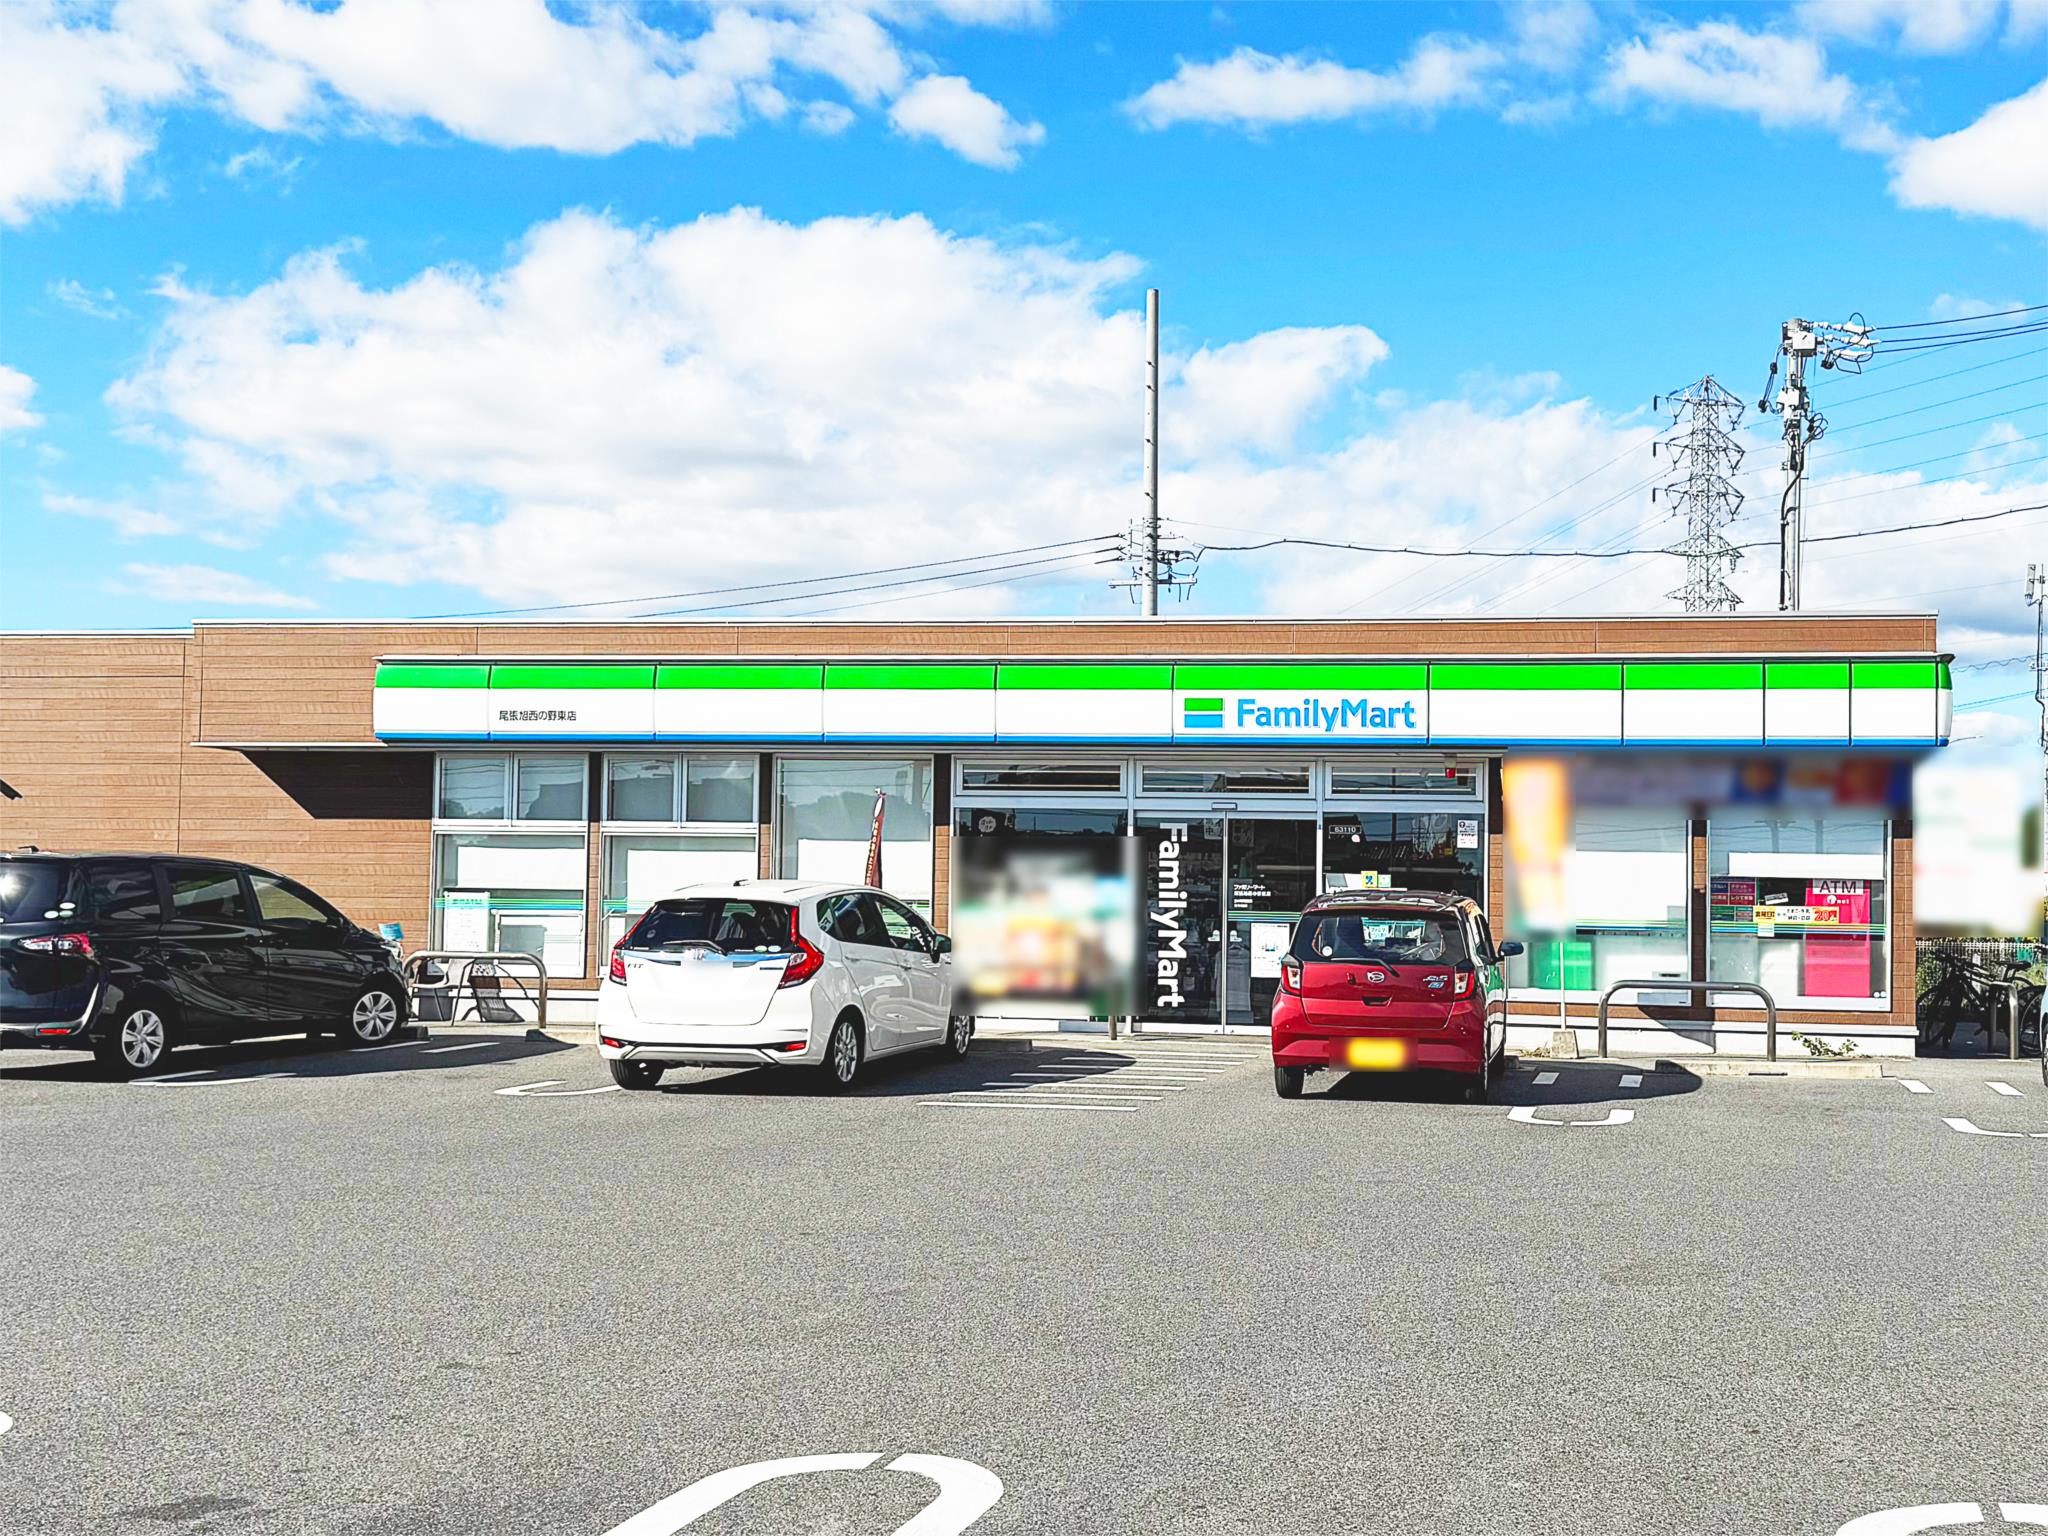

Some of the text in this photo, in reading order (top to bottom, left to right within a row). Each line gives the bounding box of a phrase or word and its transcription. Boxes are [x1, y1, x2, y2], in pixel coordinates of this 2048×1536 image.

[499, 710, 577, 721] 尾張旭西の野東店
[1237, 698, 1417, 732] FamilyMart
[1819, 880, 1857, 893] ATM
[1150, 822, 1188, 1008] FamilyMart
